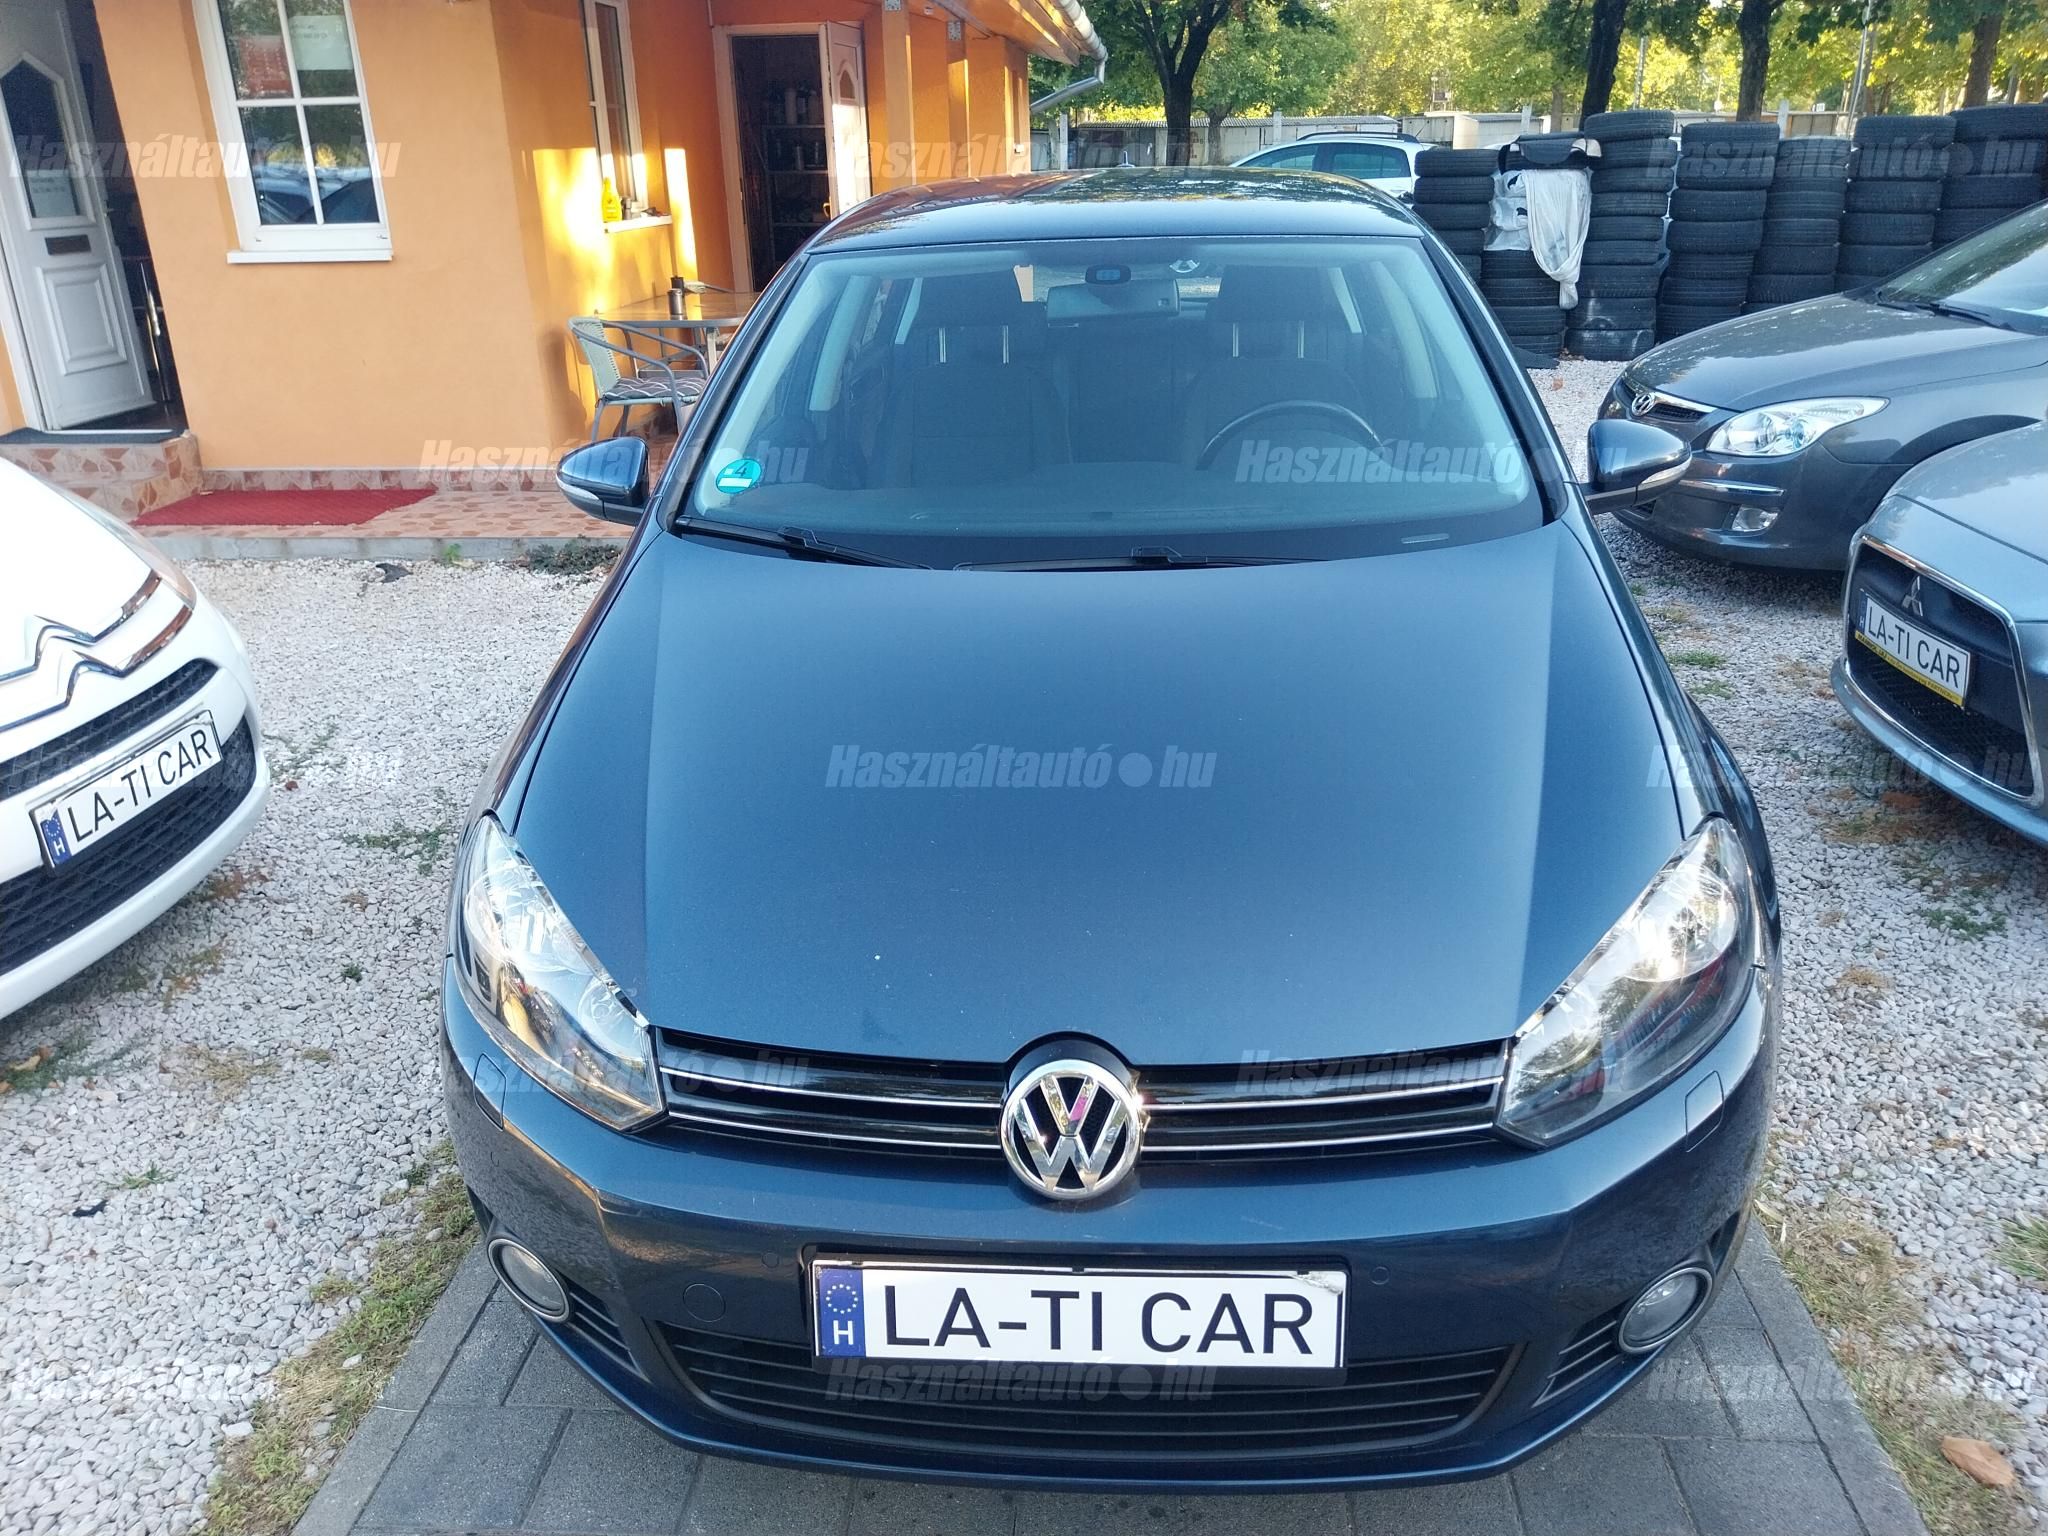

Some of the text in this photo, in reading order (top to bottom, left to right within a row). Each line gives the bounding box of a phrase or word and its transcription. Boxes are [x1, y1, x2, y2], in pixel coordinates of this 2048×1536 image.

[735, 461, 749, 477] 4
[1867, 606, 1910, 660] LA-TI
[1917, 639, 1959, 689] CAR
[53, 838, 66, 857] H
[67, 764, 152, 842] LA-TI
[157, 729, 213, 786] CAR
[1009, 1068, 1133, 1194] VW
[833, 1285, 1313, 1354] H LA-TI CAR
